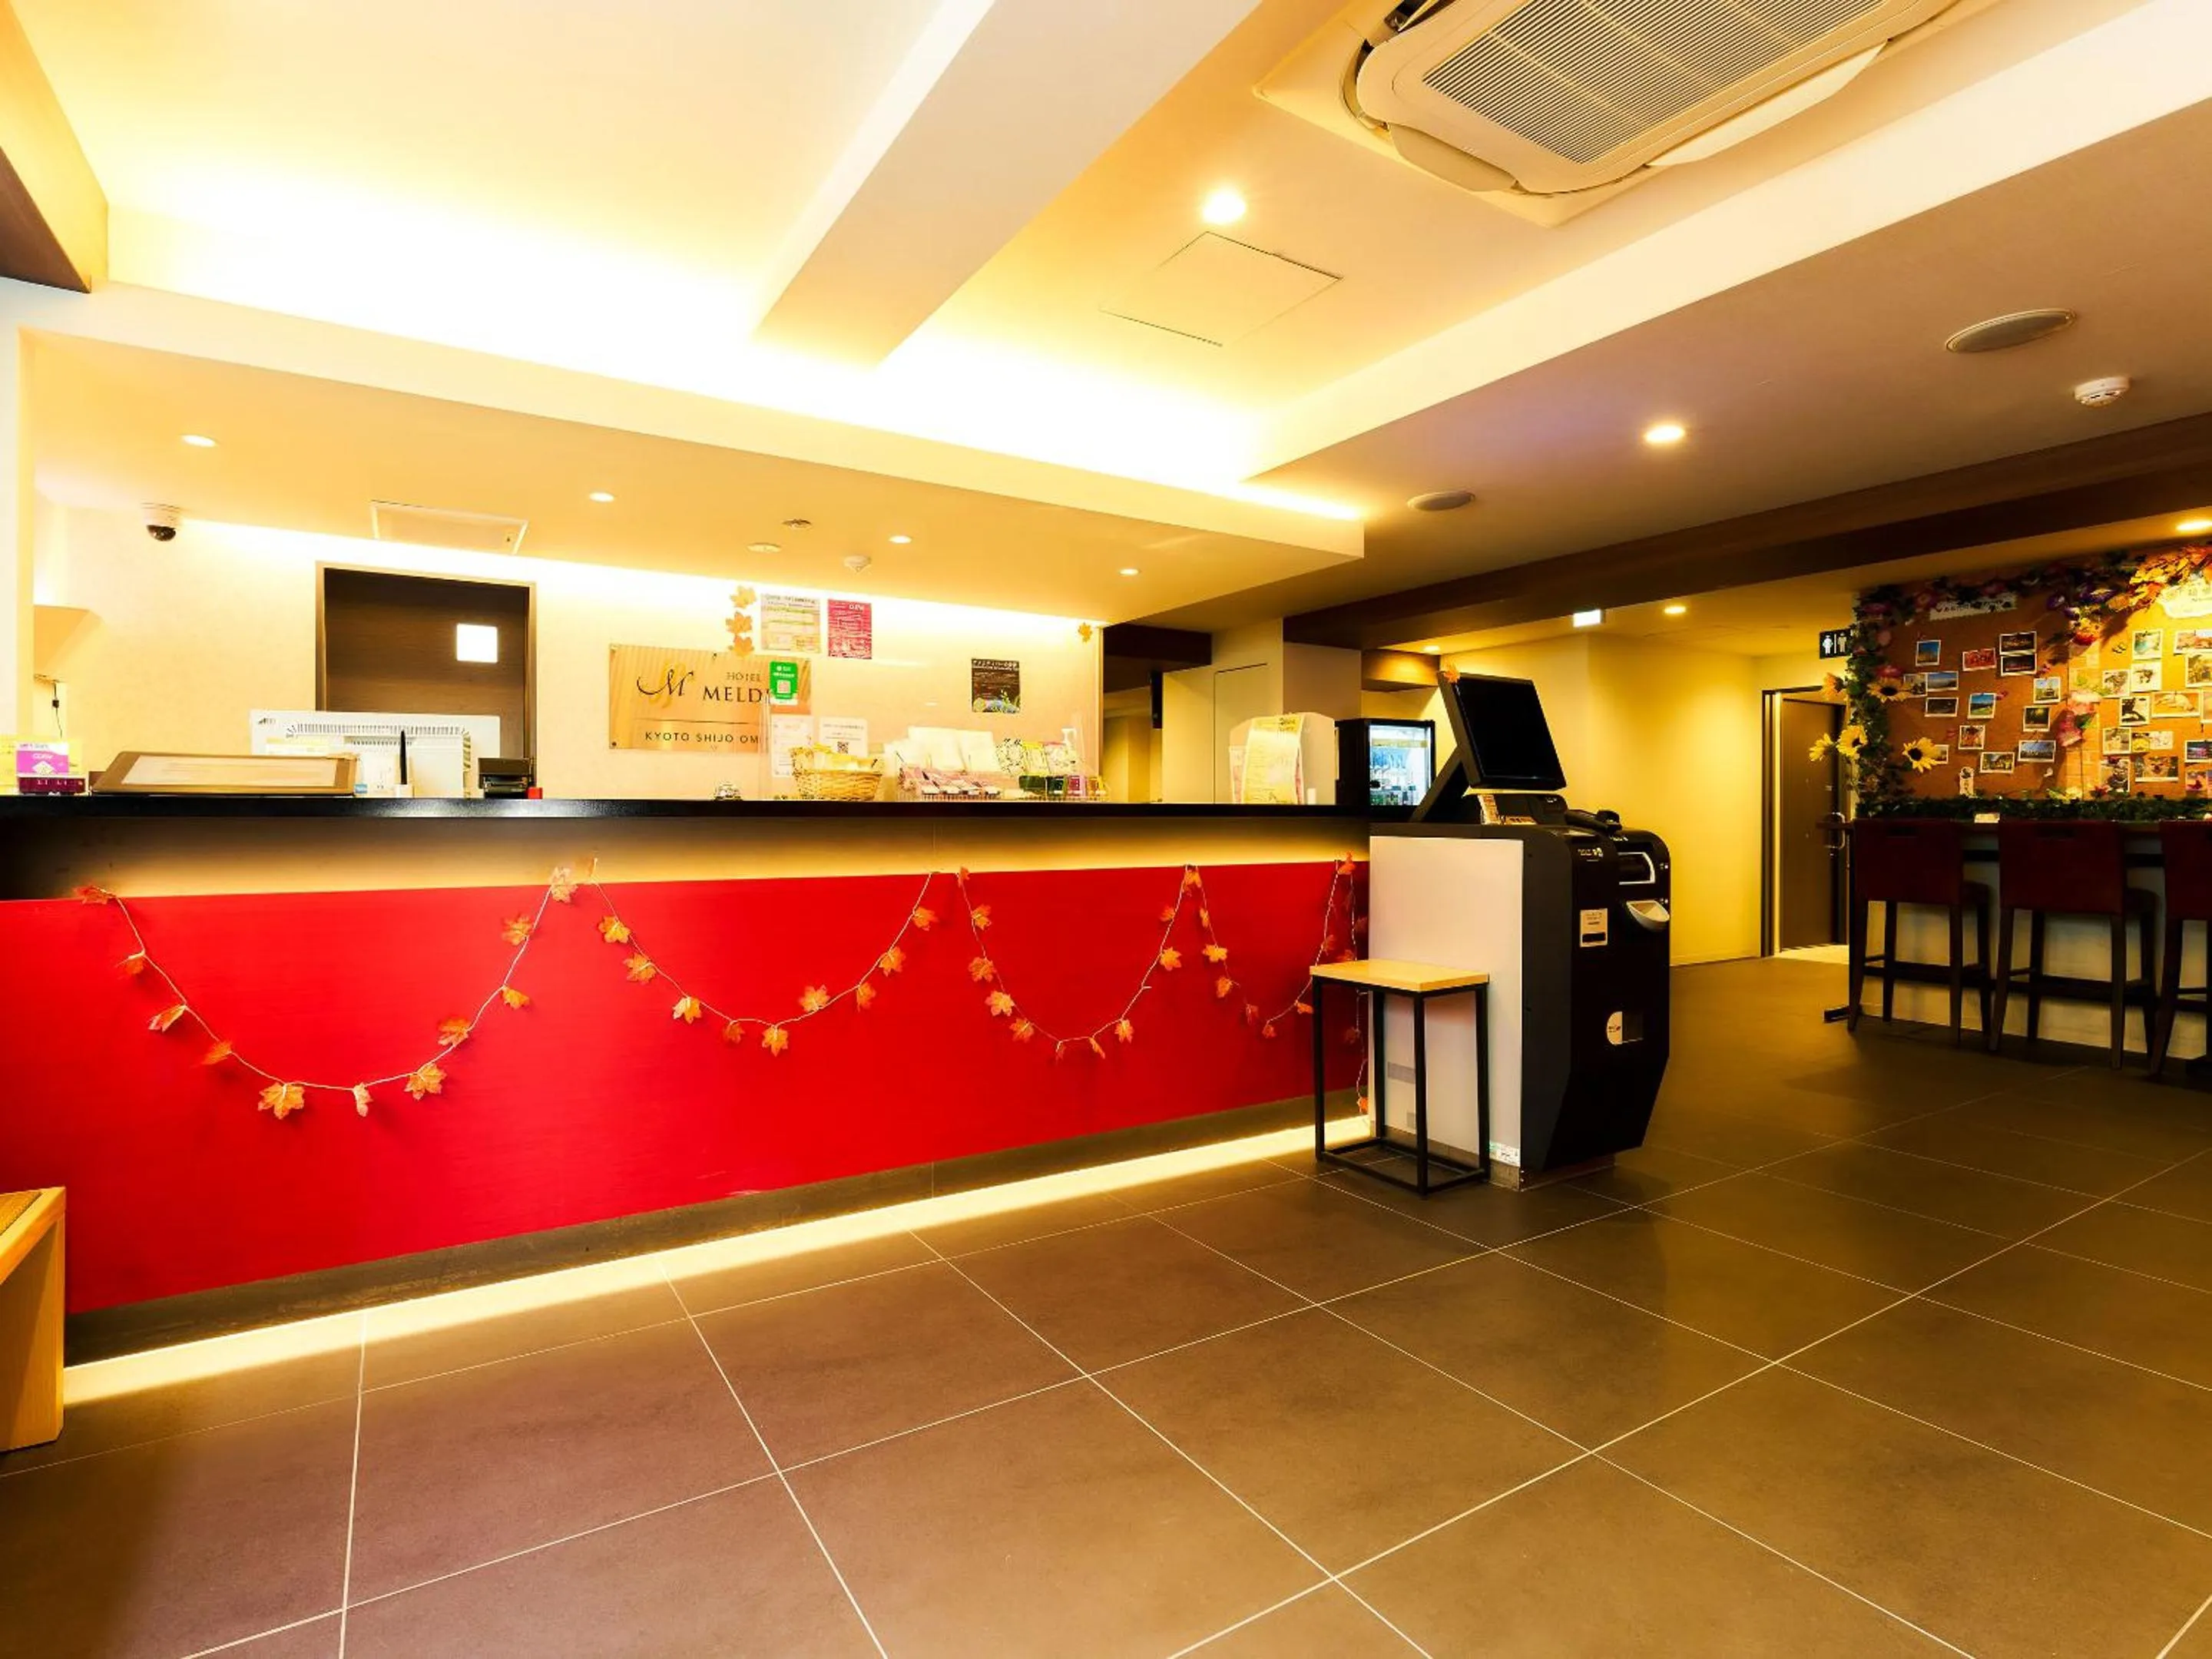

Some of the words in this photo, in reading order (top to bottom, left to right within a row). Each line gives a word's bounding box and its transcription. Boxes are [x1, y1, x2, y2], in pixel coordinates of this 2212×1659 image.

[726, 671, 761, 682] HOTEL
[644, 732, 690, 742] KYOTO
[696, 733, 734, 743] SHIJO
[740, 735, 759, 744] OM
